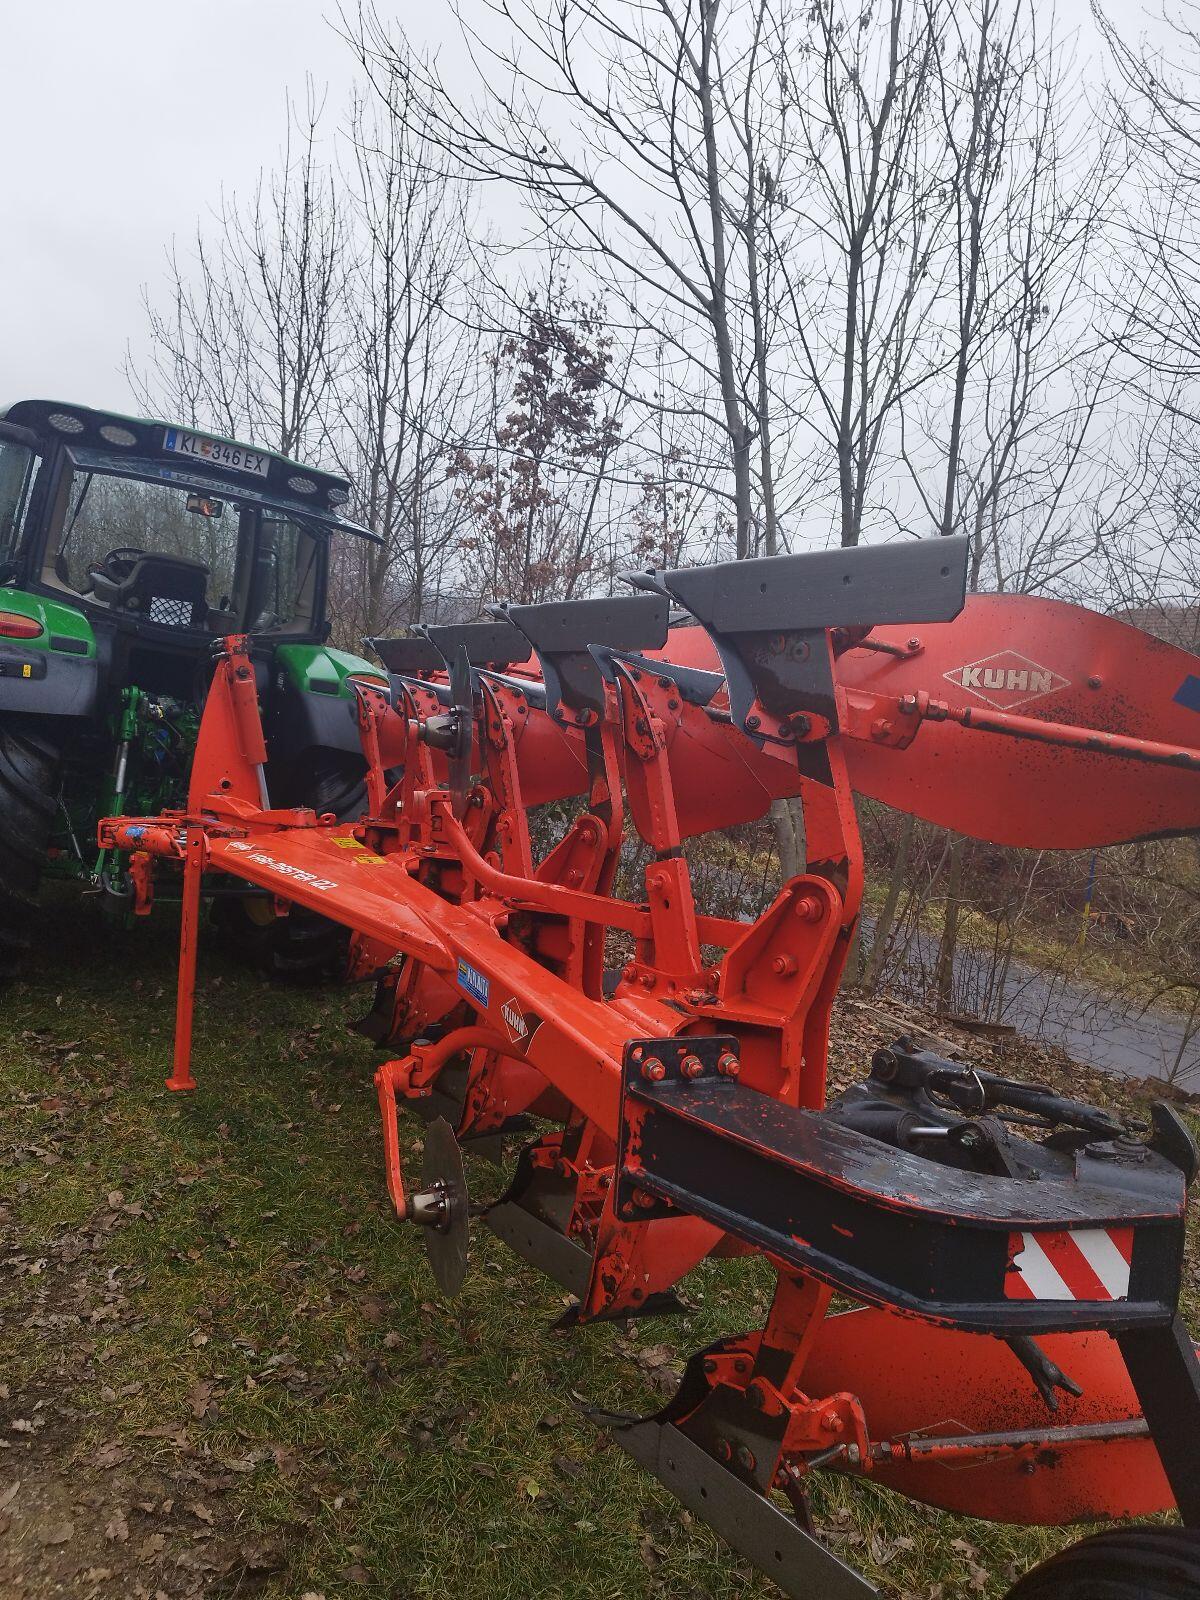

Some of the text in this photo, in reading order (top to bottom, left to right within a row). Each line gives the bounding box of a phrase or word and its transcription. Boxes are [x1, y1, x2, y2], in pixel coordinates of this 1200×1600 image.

[182, 436, 198, 454] KL
[212, 445, 241, 465] 346
[244, 454, 264, 472] EX
[961, 667, 1052, 692] KUHN
[504, 1003, 527, 1037] KUHN
